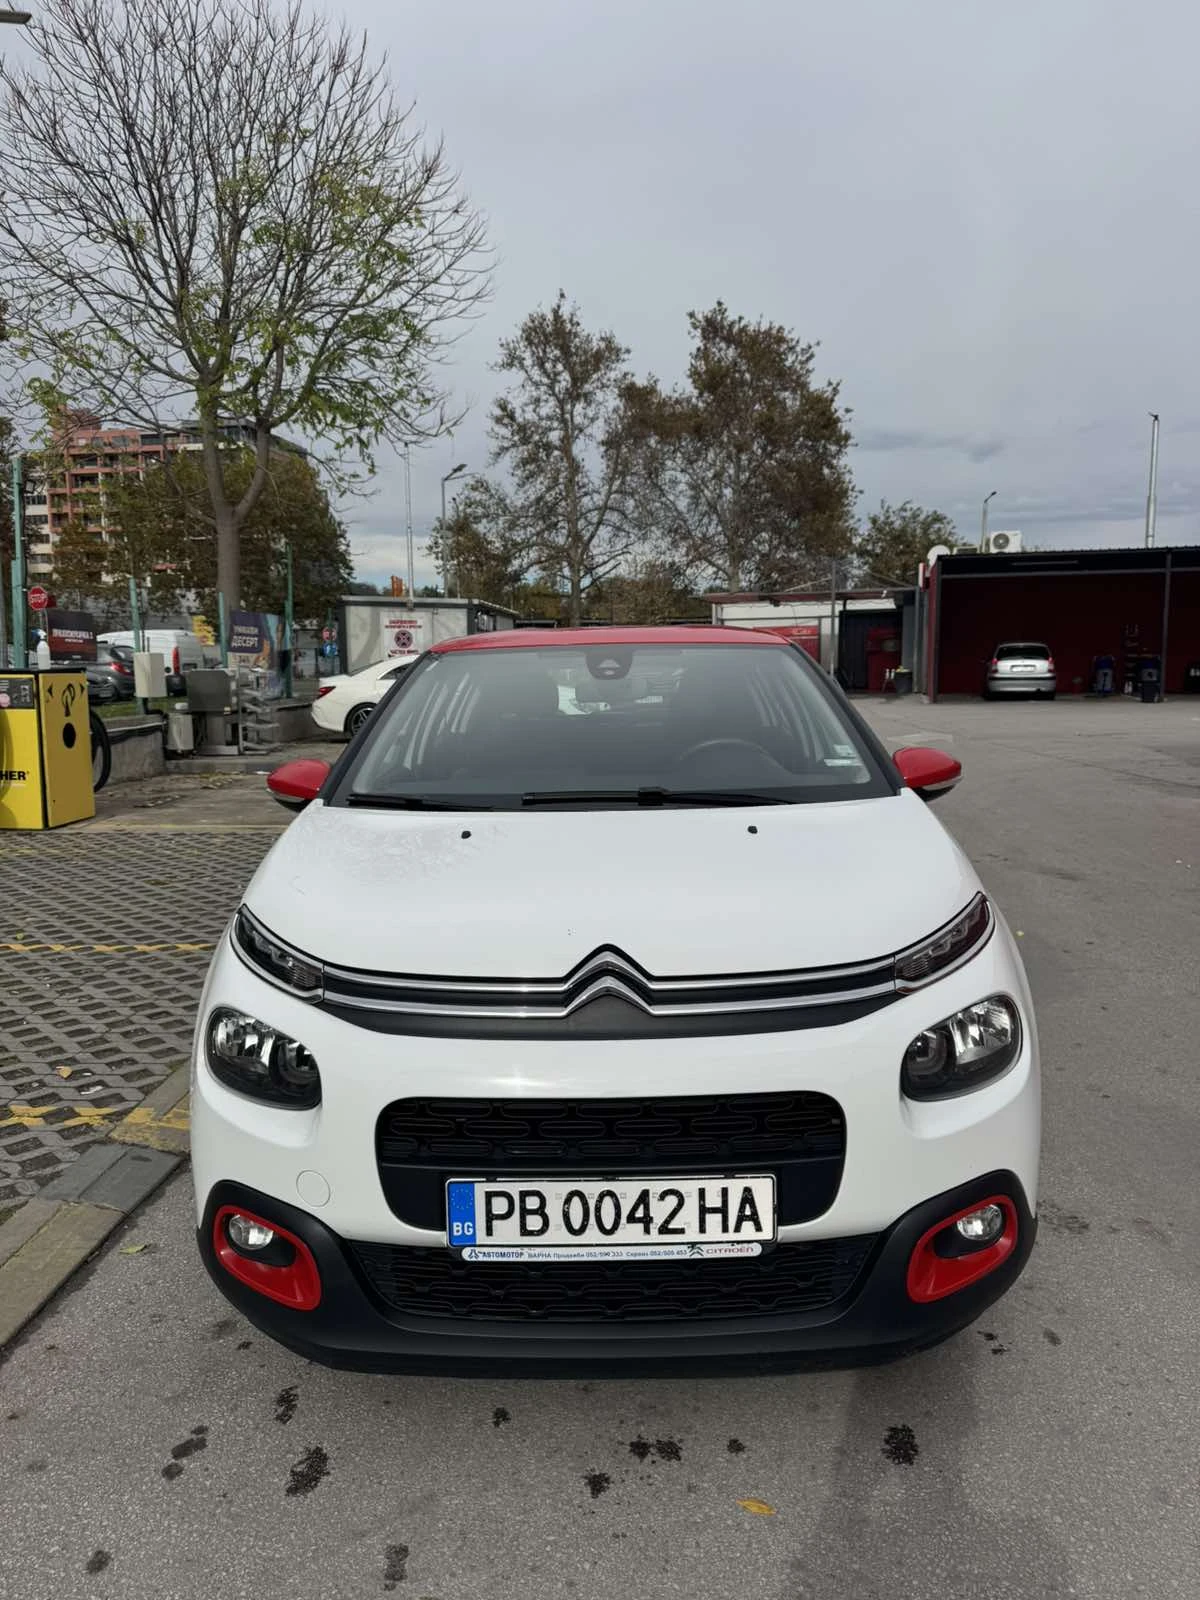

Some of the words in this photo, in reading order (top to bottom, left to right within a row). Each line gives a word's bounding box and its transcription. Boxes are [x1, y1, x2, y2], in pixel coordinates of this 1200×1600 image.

[484, 1188, 550, 1237] PB
[562, 1187, 686, 1237] 0042
[699, 1186, 763, 1234] HA
[453, 1221, 473, 1236] BG
